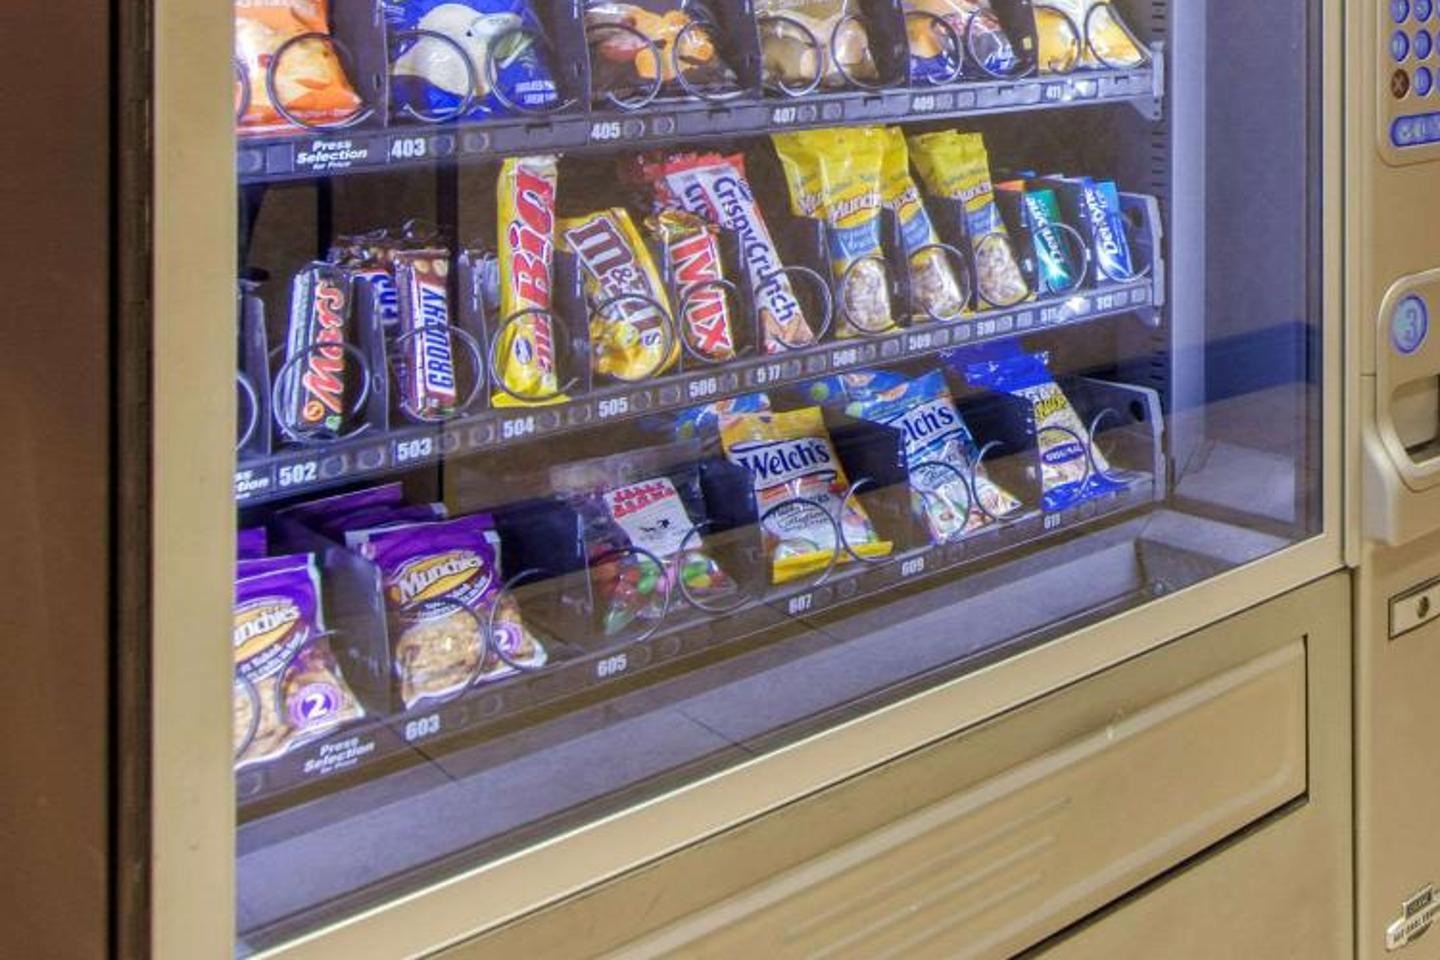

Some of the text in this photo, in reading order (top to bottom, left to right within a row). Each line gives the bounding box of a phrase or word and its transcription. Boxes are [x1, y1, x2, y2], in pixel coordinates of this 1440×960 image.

[772, 106, 796, 124] 407
[590, 121, 621, 140] 405
[296, 147, 369, 166] Selection
[312, 139, 353, 153] Press
[391, 138, 426, 158] 403
[746, 240, 797, 322] Crunch
[302, 280, 345, 415] Mars
[598, 397, 629, 417] 505
[503, 418, 536, 439] 504
[396, 438, 432, 460] 503
[738, 443, 831, 481] Welch's
[279, 461, 317, 487] 502
[597, 653, 628, 678] 605
[306, 695, 329, 719] 2
[405, 714, 441, 741] 603
[303, 742, 376, 773] Selection
[319, 738, 360, 757] Press
